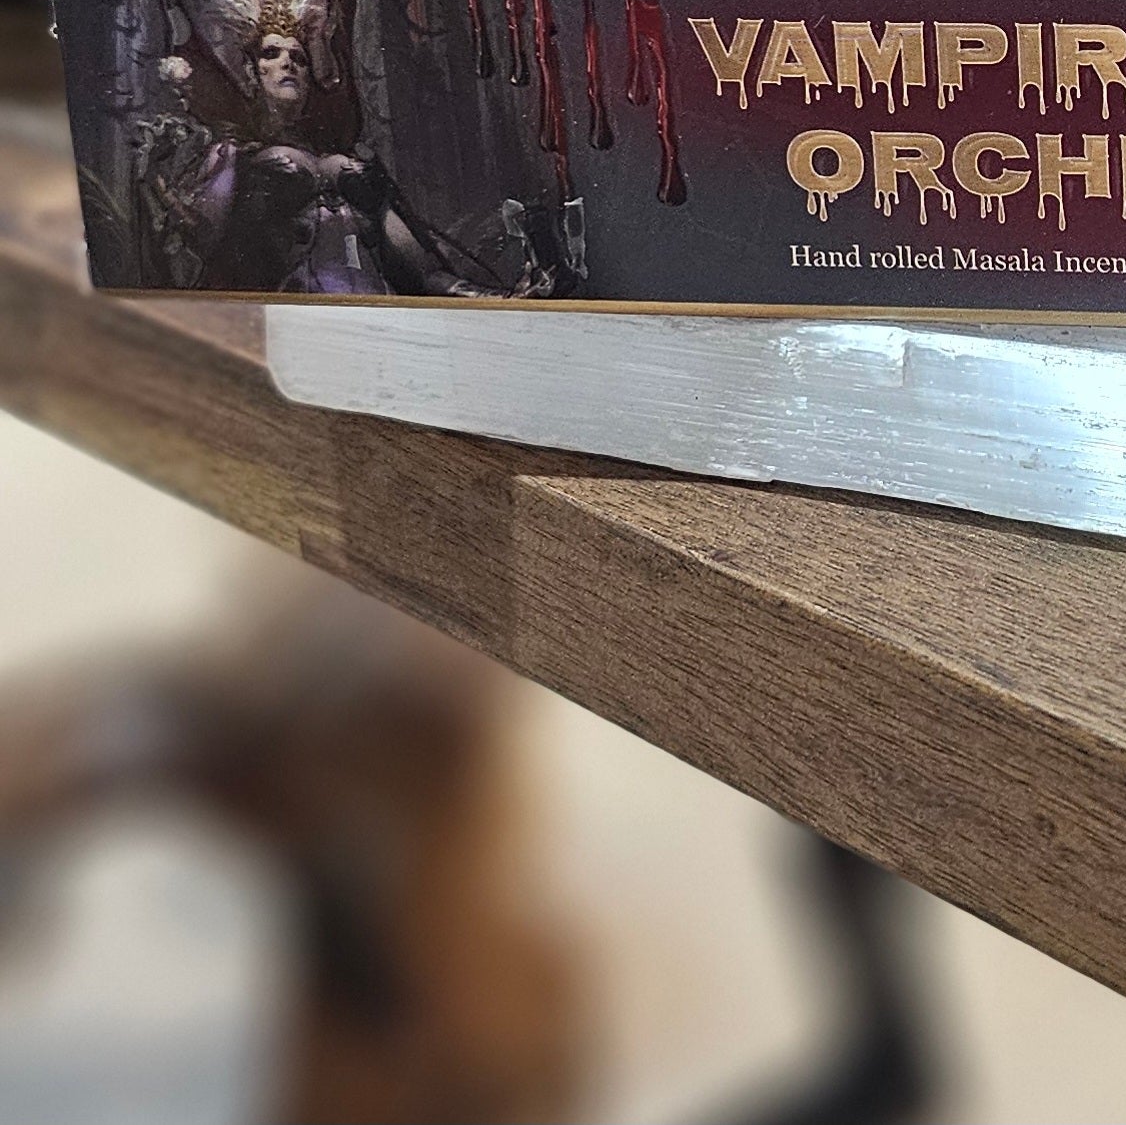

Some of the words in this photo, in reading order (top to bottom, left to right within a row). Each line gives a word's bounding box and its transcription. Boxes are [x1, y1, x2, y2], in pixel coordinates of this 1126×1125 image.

[789, 245, 862, 269] Hand
[869, 246, 945, 271] rolled
[952, 248, 1046, 273] Masala
